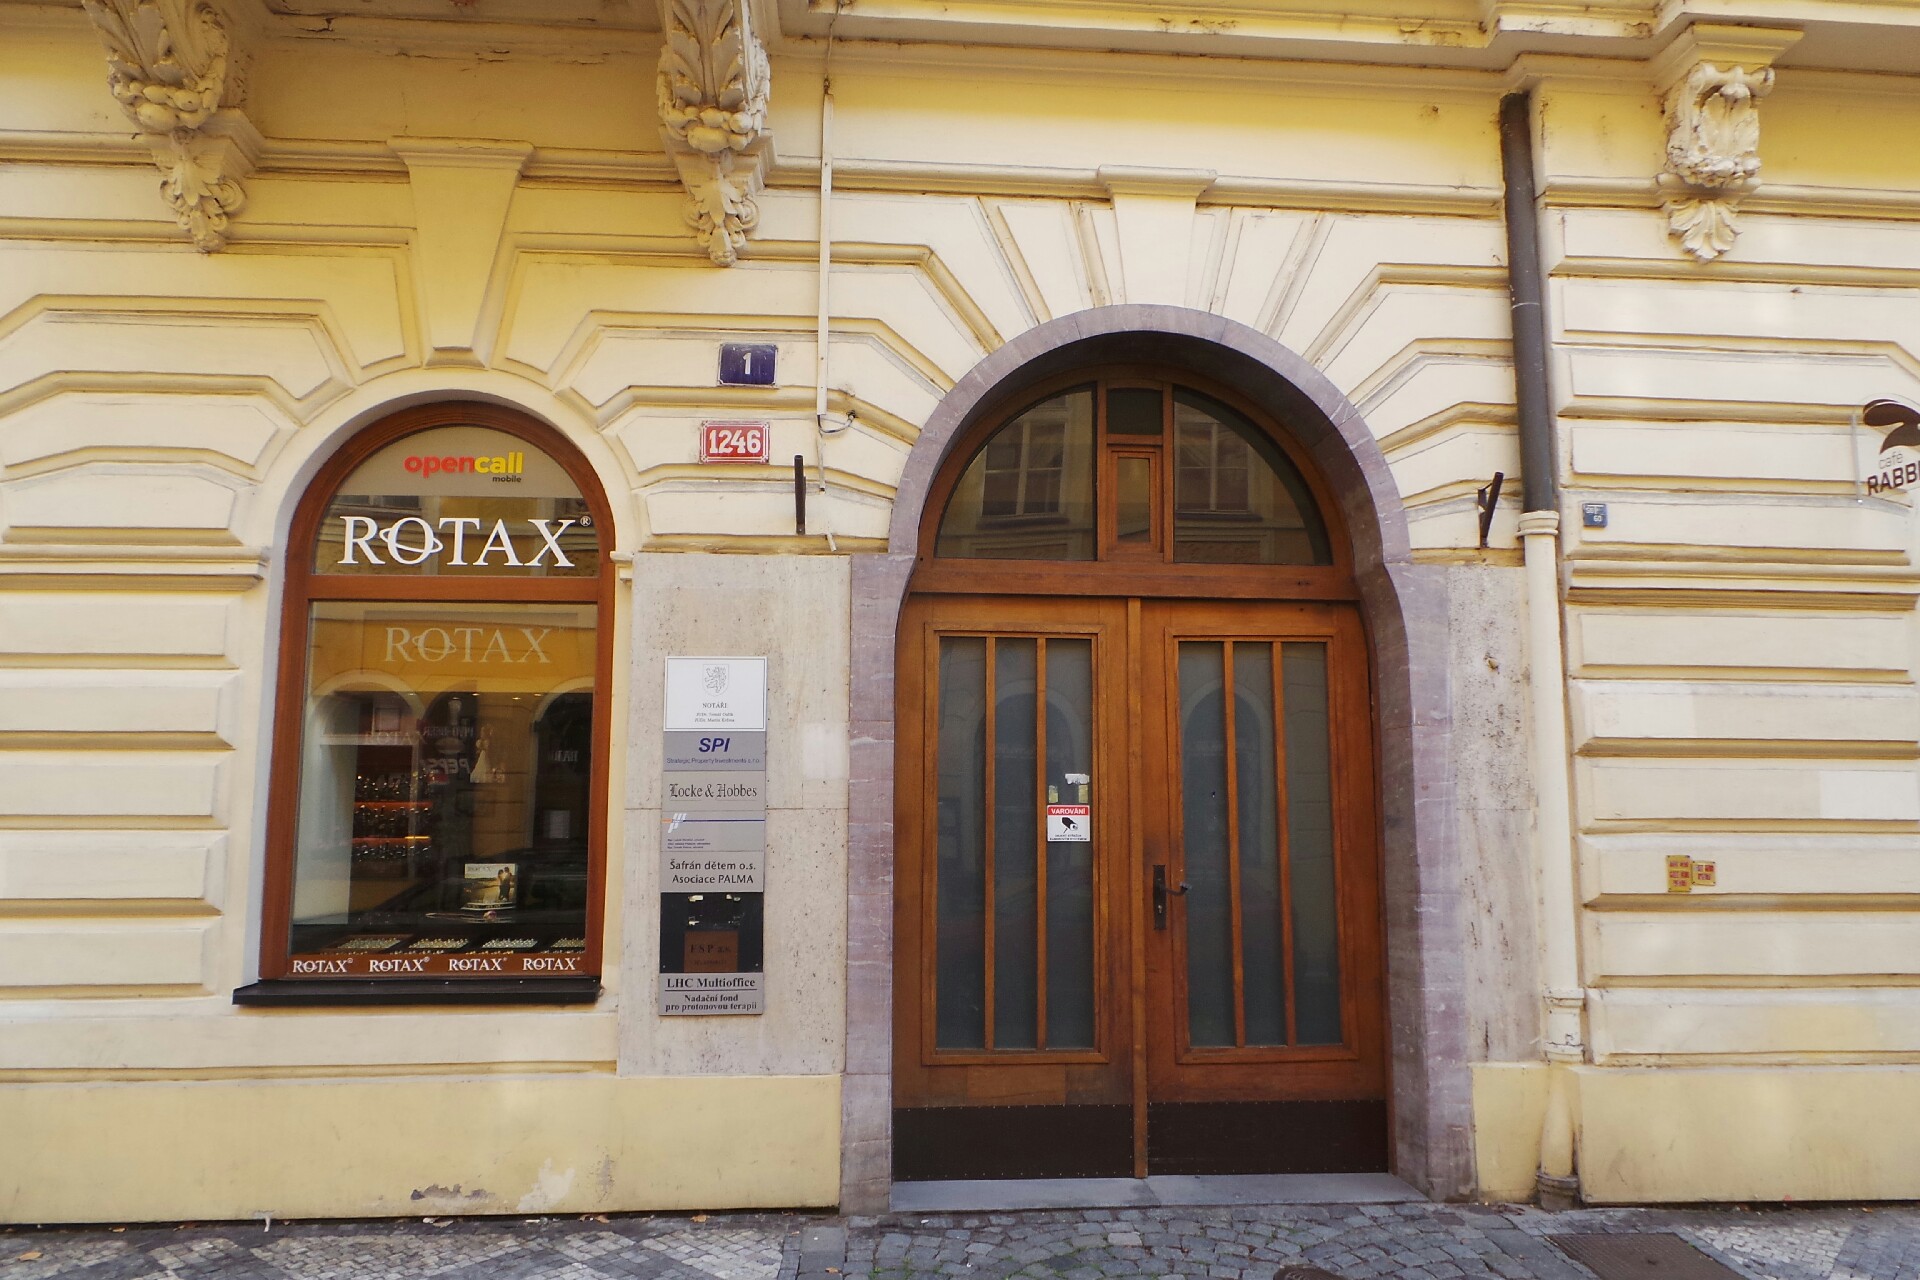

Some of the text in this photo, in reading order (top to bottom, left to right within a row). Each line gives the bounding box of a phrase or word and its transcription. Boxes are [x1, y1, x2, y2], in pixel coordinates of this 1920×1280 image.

[743, 352, 751, 375] 1
[709, 429, 761, 454] 1246
[403, 452, 524, 478] opencall
[492, 475, 522, 483] mobile
[698, 737, 731, 753] SPI
[691, 757, 714, 765] Property
[669, 783, 757, 798] Locke & Hobbes
[670, 859, 756, 870] Šafrán dětem o.s.
[672, 874, 754, 884] Asociace PALMA
[667, 978, 756, 988] LHC Multioffice
[720, 994, 739, 1002] fond
[665, 1002, 757, 1013] pro protonovou terapii
